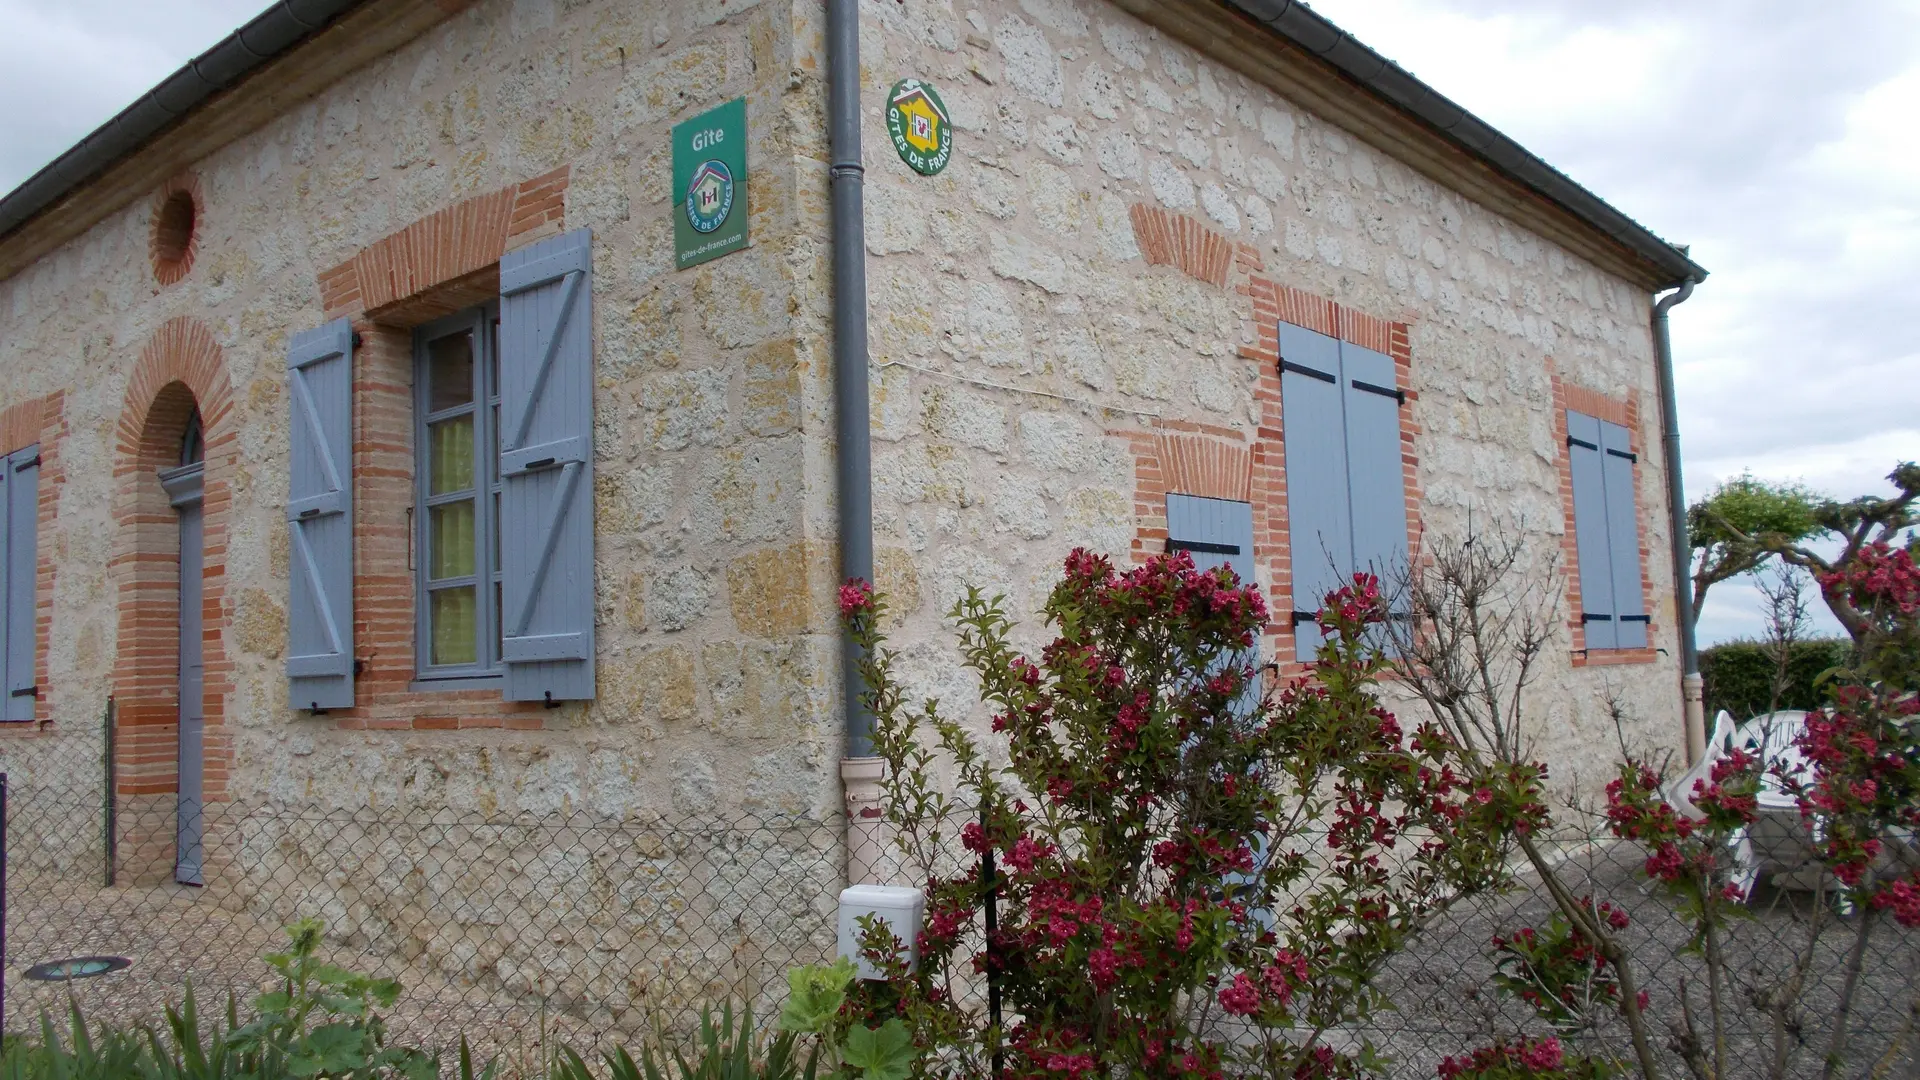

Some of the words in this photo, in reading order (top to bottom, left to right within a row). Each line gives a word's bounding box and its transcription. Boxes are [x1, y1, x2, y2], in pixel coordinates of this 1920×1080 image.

[692, 128, 724, 151] Gîte
[889, 107, 908, 152] GITES
[909, 151, 924, 169] DE
[928, 128, 950, 170] FRANCE
[714, 184, 732, 225] FRANCE
[681, 233, 742, 262] gites-de-france.com
